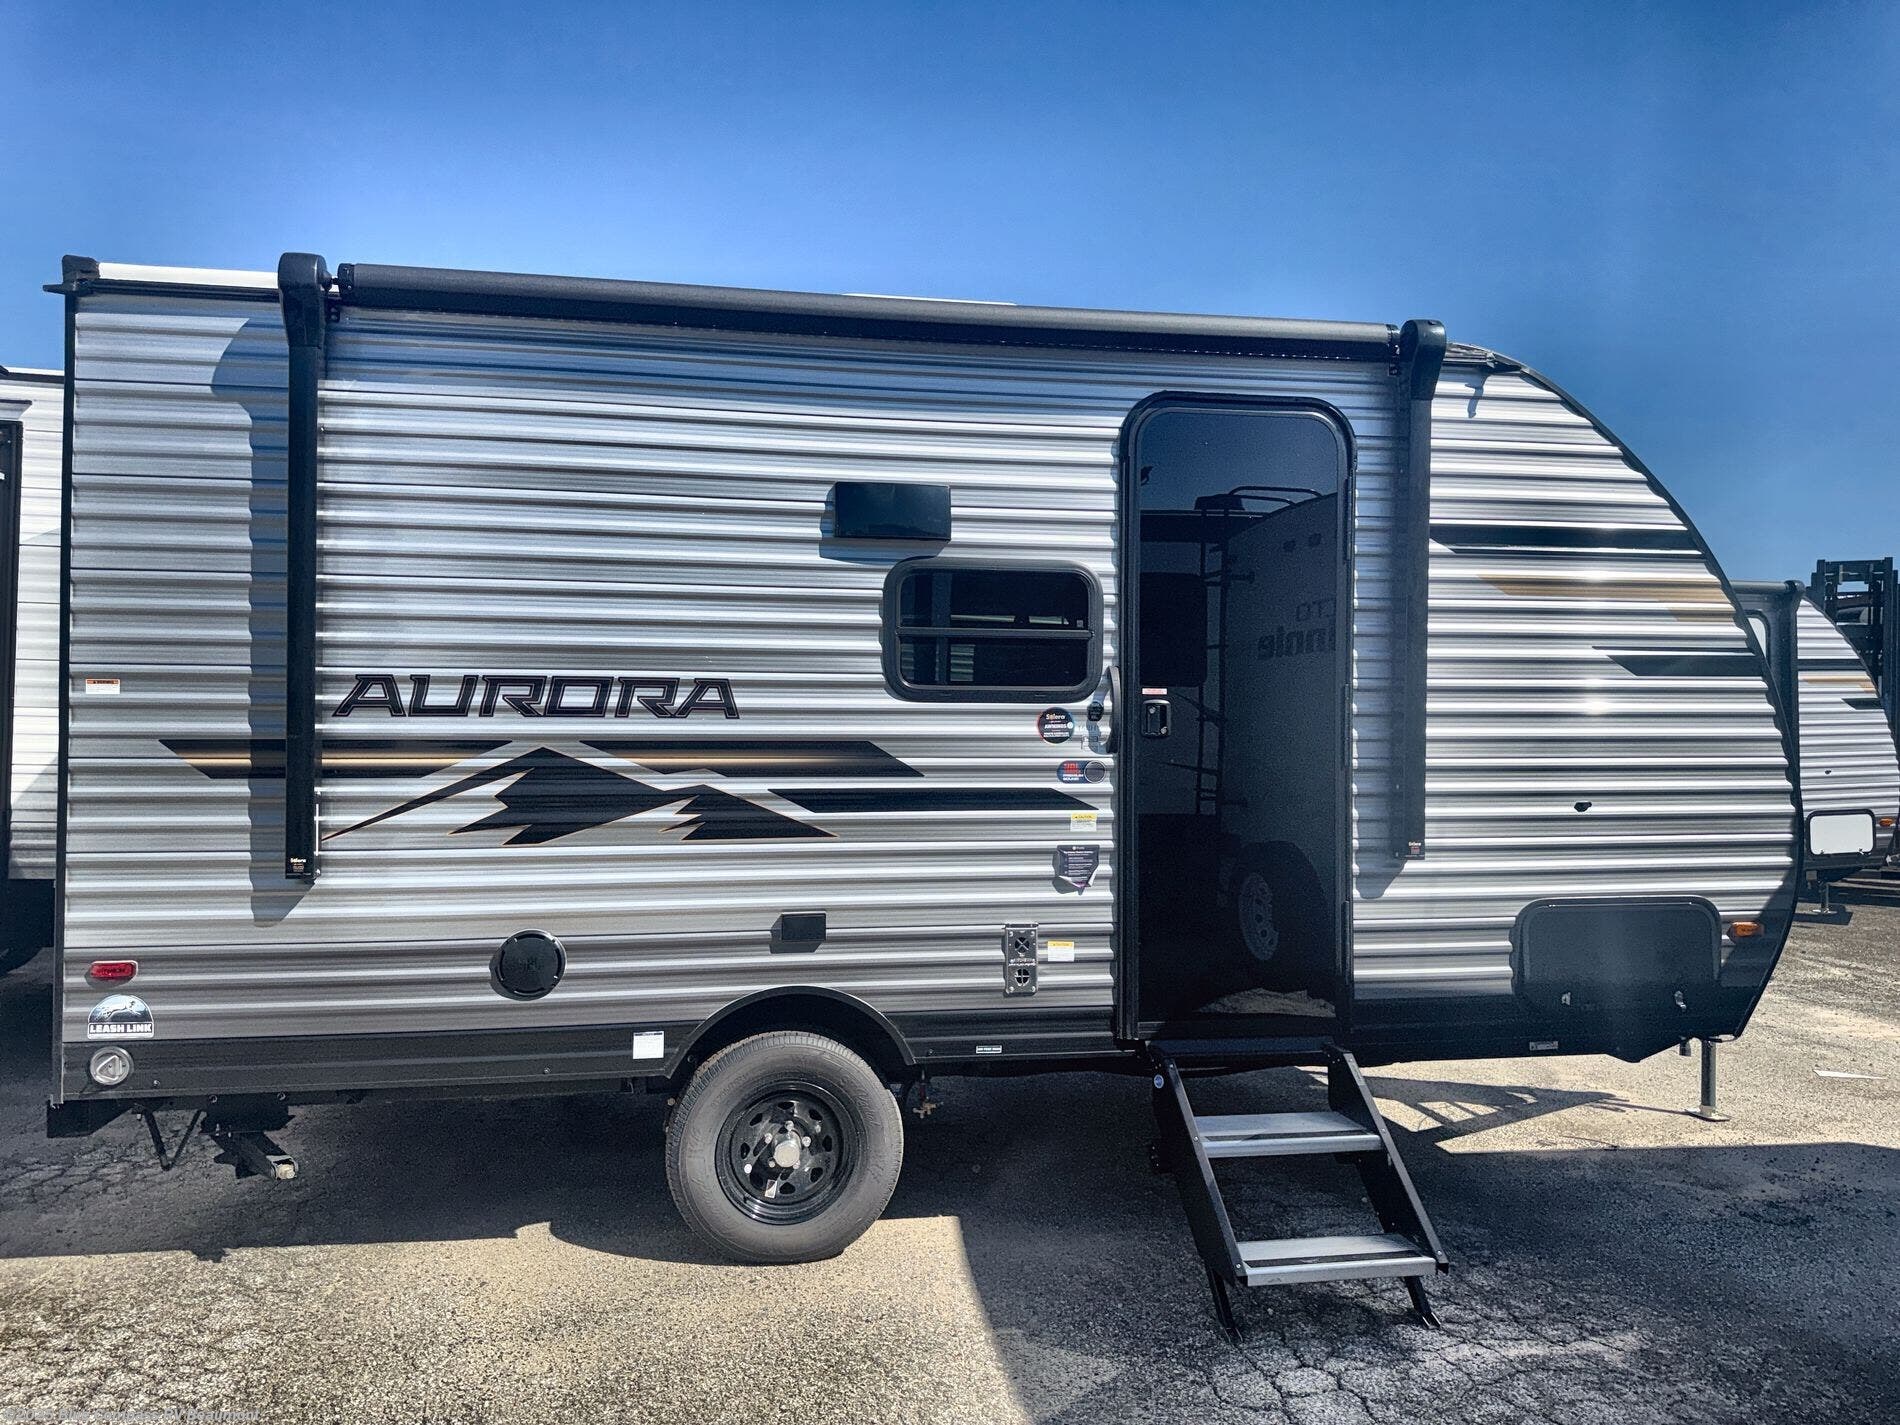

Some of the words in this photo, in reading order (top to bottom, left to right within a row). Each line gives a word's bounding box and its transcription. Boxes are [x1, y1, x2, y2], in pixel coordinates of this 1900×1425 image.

[331, 673, 741, 720] AURORA
[89, 1024, 125, 1033] LEASH
[126, 1023, 152, 1033] LINK
